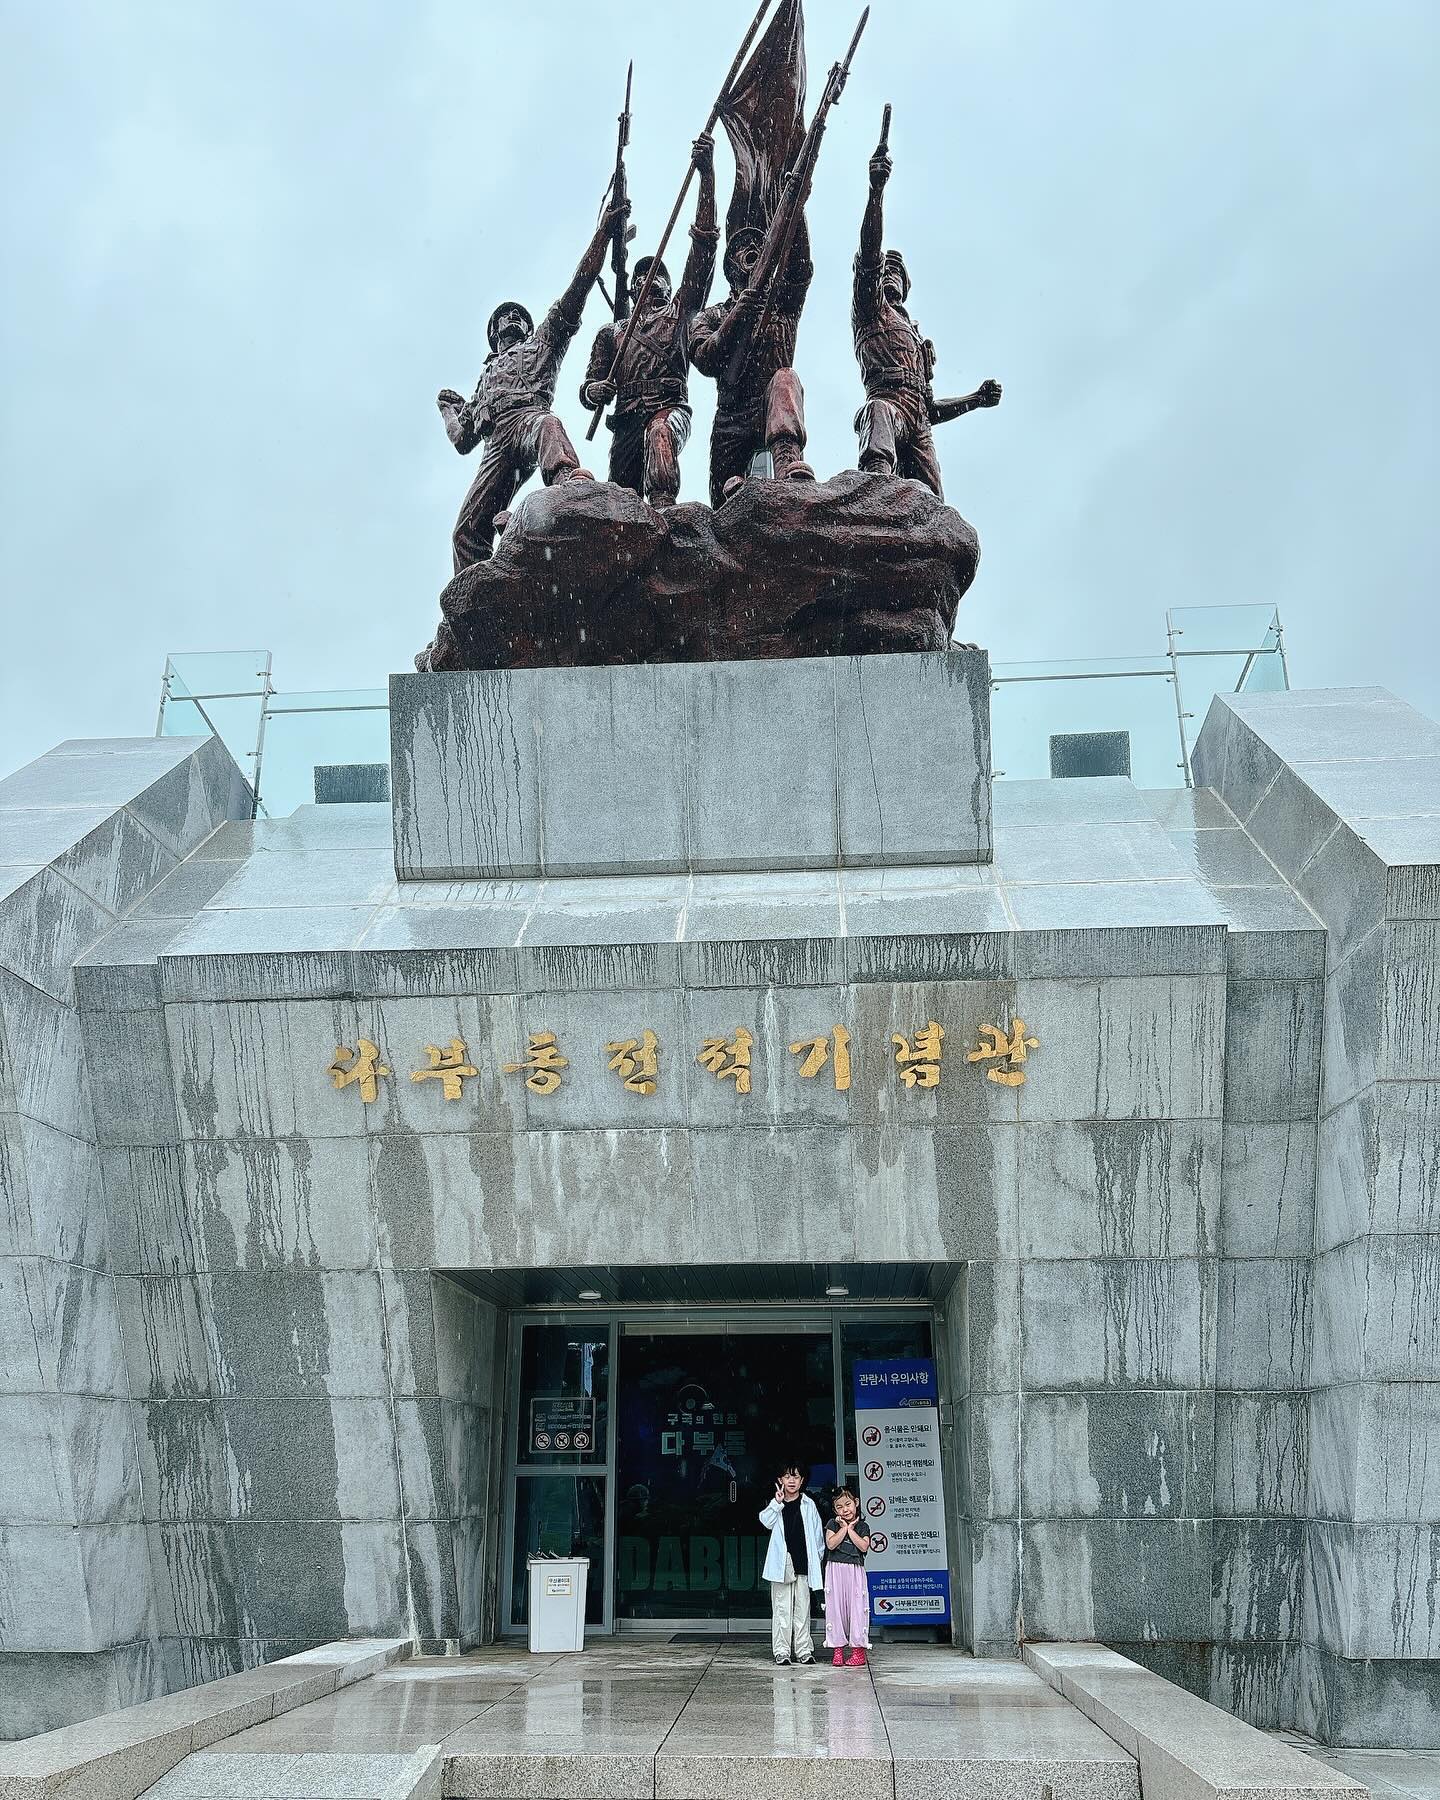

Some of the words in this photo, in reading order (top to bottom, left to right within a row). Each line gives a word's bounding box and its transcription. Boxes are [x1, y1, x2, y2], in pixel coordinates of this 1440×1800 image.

[327, 1018, 1040, 1103] 다부동전적기념관
[859, 1373, 888, 1386] 관람시
[890, 1371, 929, 1385] 유의사항
[667, 1413, 704, 1425] 구국의
[884, 1425, 910, 1434] 음식물은
[888, 1496, 908, 1504] 담배는
[909, 1495, 938, 1503] 해로워요!
[620, 1535, 772, 1591] DABU
